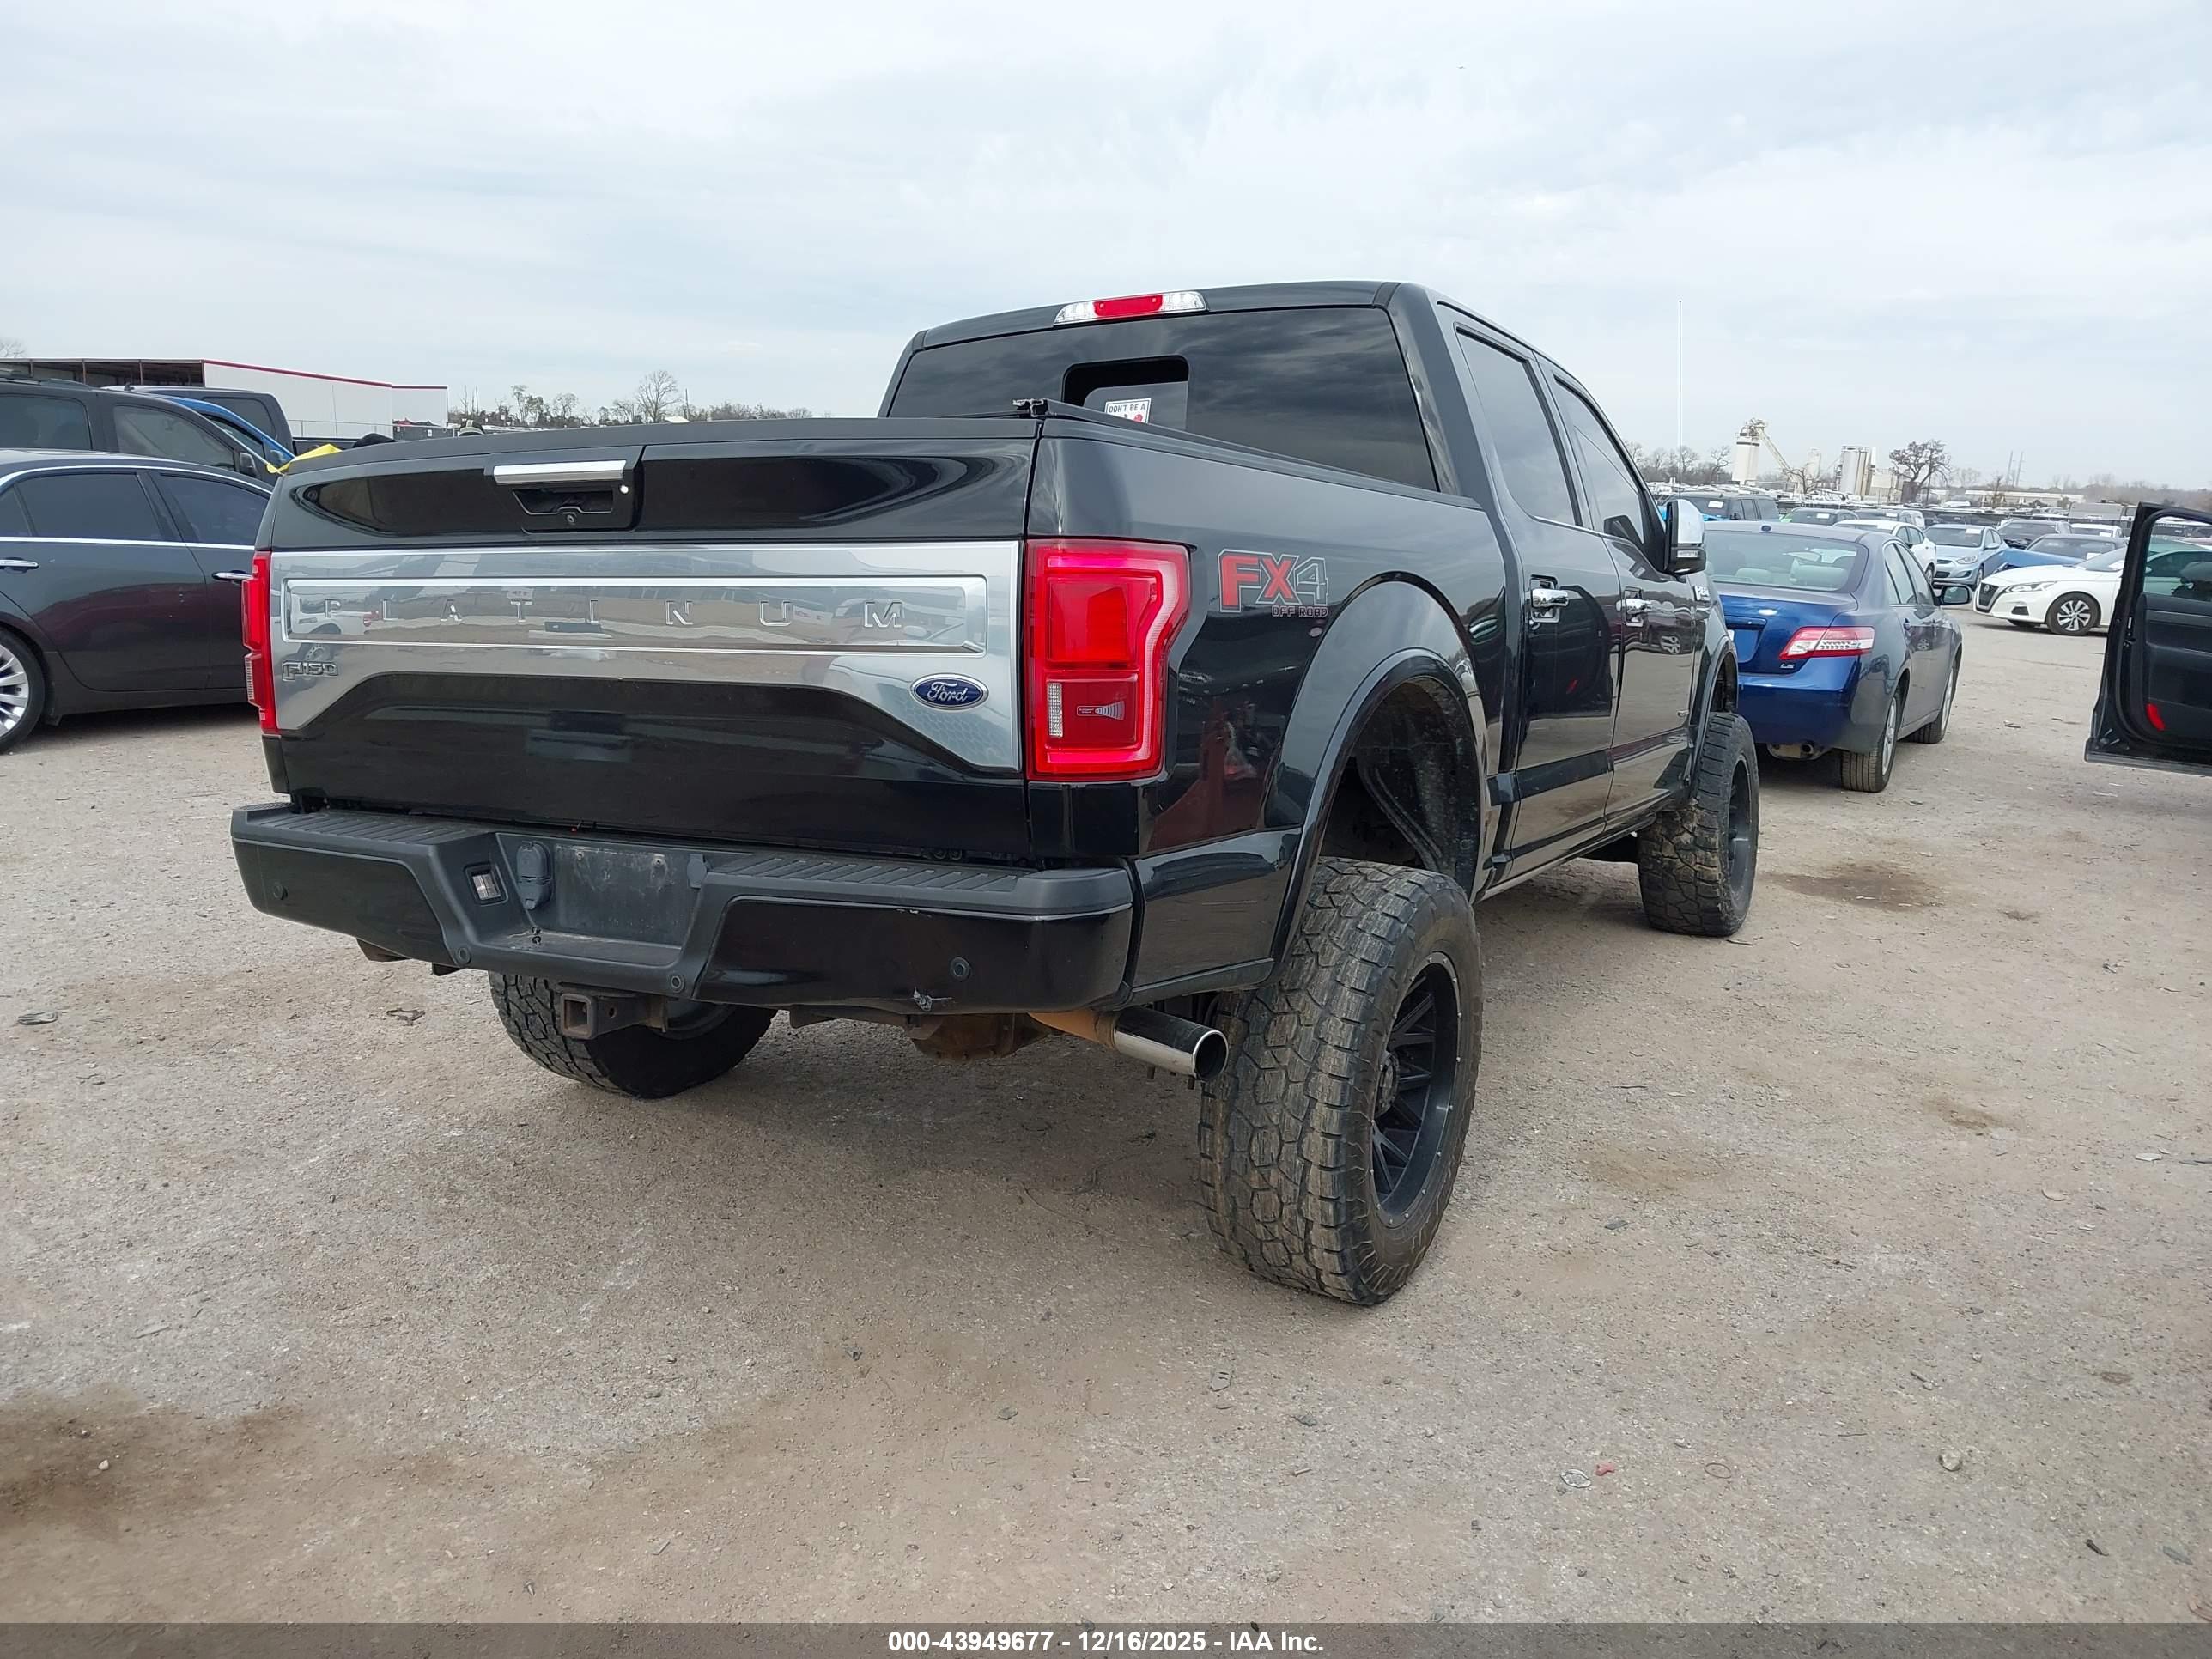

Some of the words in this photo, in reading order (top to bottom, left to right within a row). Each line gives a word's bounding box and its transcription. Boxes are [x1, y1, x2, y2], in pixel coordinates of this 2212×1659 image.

[1218, 549, 1328, 612] FX4
[324, 599, 902, 628] PLATINUM
[1271, 605, 1296, 617] OFF
[1298, 606, 1328, 618] ROAD
[927, 681, 969, 702] Ford
